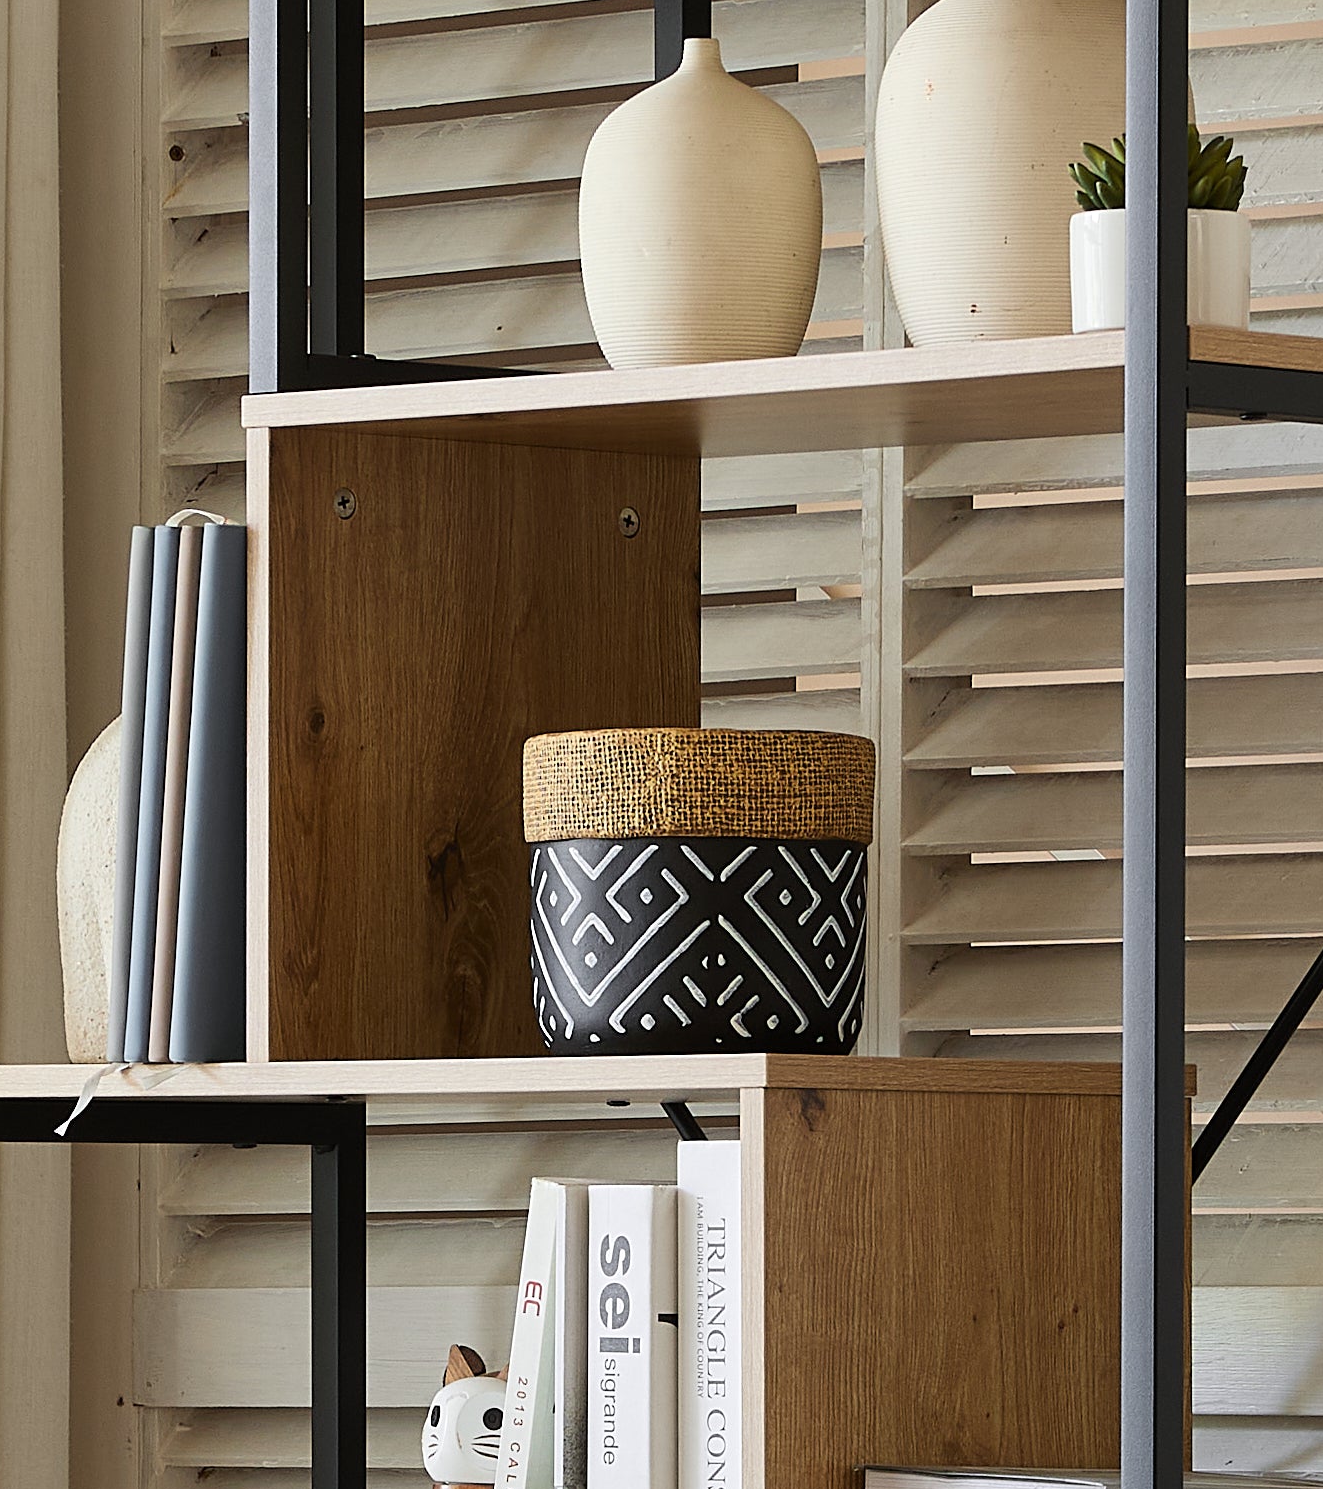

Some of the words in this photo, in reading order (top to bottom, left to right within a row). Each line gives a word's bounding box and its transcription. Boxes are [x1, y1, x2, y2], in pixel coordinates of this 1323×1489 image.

[696, 1203, 704, 1219] AM
[522, 1280, 544, 1317] EC
[599, 1233, 641, 1354] sei
[696, 1278, 704, 1299] THE
[706, 1217, 726, 1399] TRIANGLE
[696, 1302, 704, 1329] KING
[696, 1331, 704, 1345] OF
[696, 1348, 704, 1399] COUNTRY
[512, 1376, 529, 1428] 2013
[599, 1357, 621, 1466] sigrande
